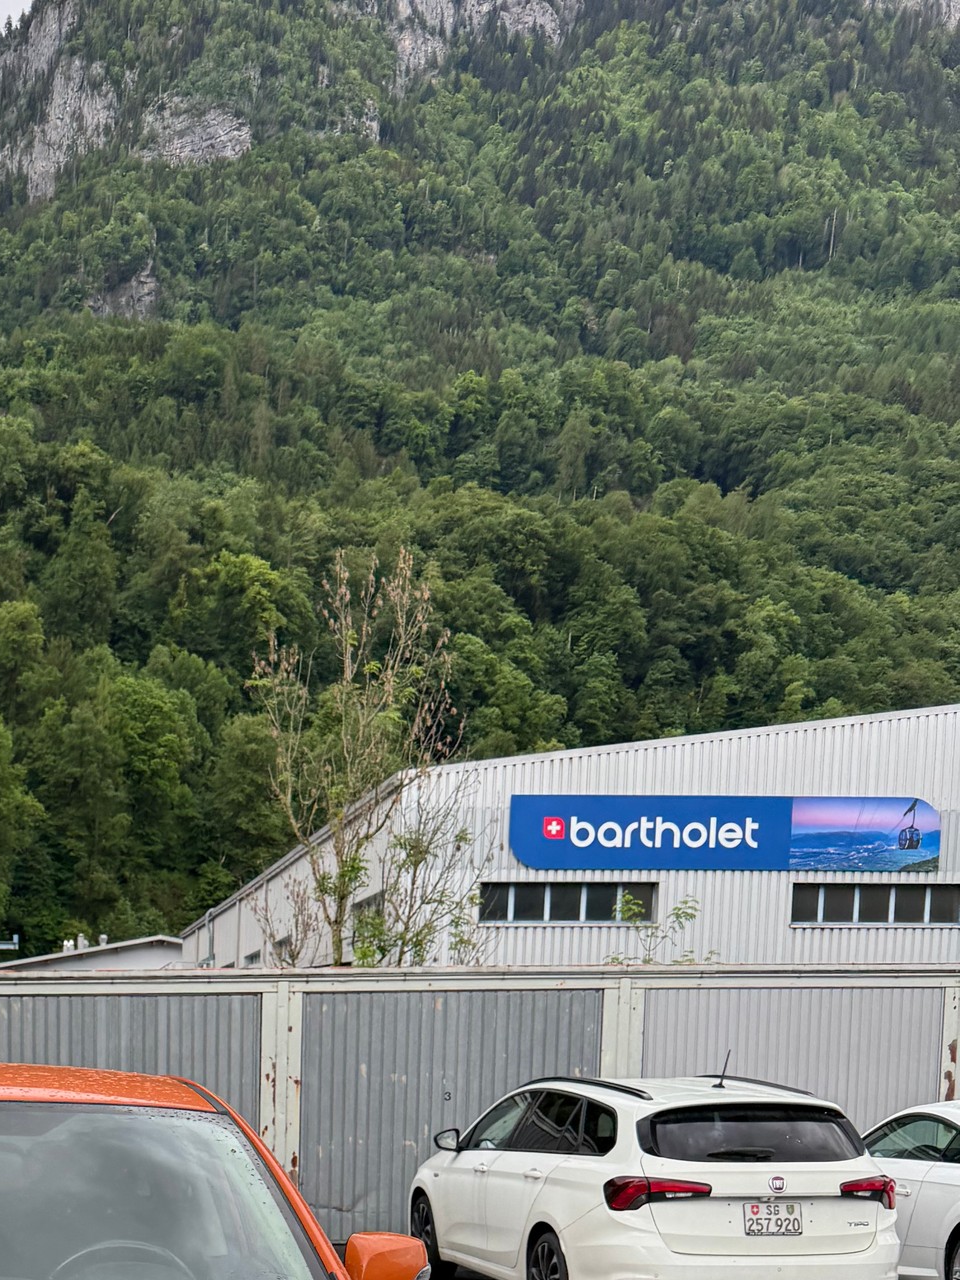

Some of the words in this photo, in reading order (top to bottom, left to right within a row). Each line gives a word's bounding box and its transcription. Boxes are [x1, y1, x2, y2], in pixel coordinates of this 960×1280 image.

[570, 816, 759, 848] bartholet
[444, 1091, 451, 1101] 3
[766, 1204, 780, 1216] SG
